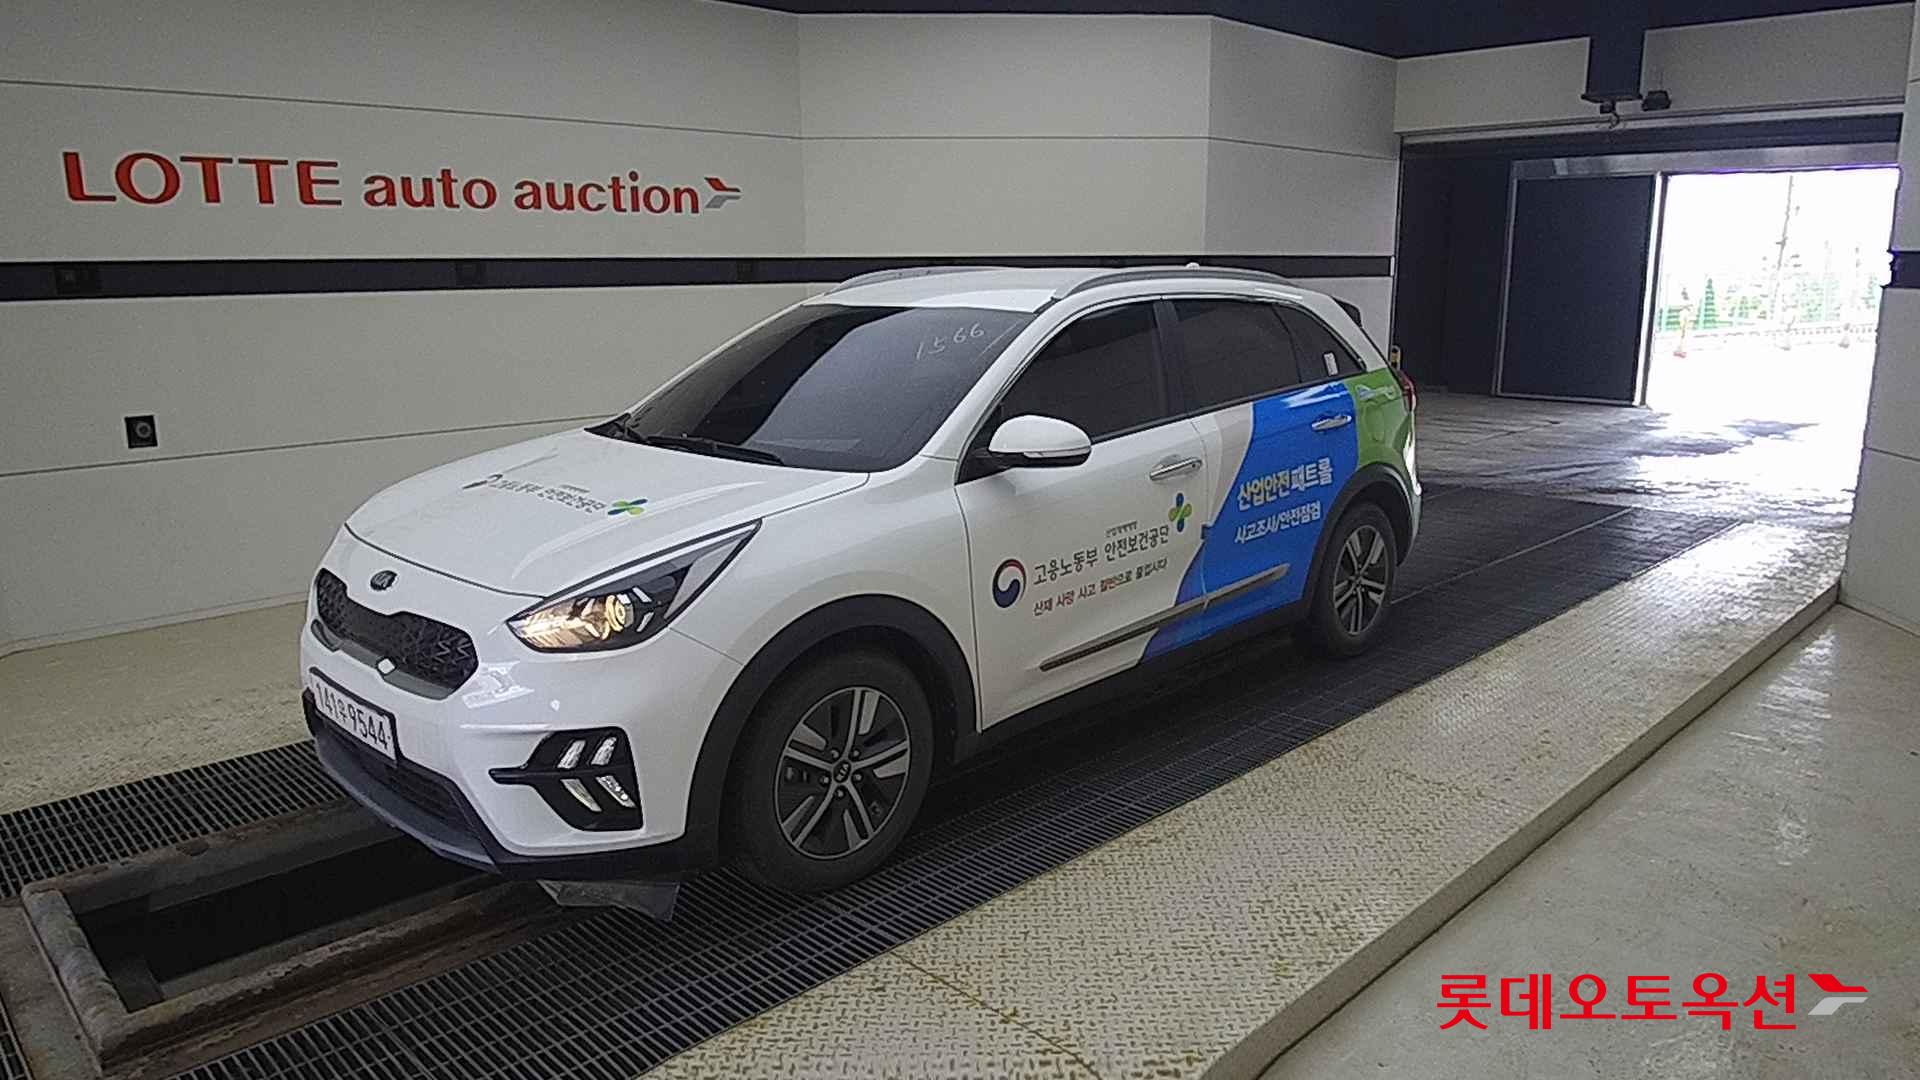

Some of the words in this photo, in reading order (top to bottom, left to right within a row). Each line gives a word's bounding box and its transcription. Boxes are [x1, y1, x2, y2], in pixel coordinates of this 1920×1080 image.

[62, 151, 343, 206] LOTTE
[363, 168, 498, 210] auto
[513, 171, 700, 214] auction
[916, 322, 985, 360] 1566
[1237, 457, 1333, 511] 산업안전패트롤
[1033, 546, 1098, 585] 고용노동부
[1104, 524, 1169, 561] 안전보건공단
